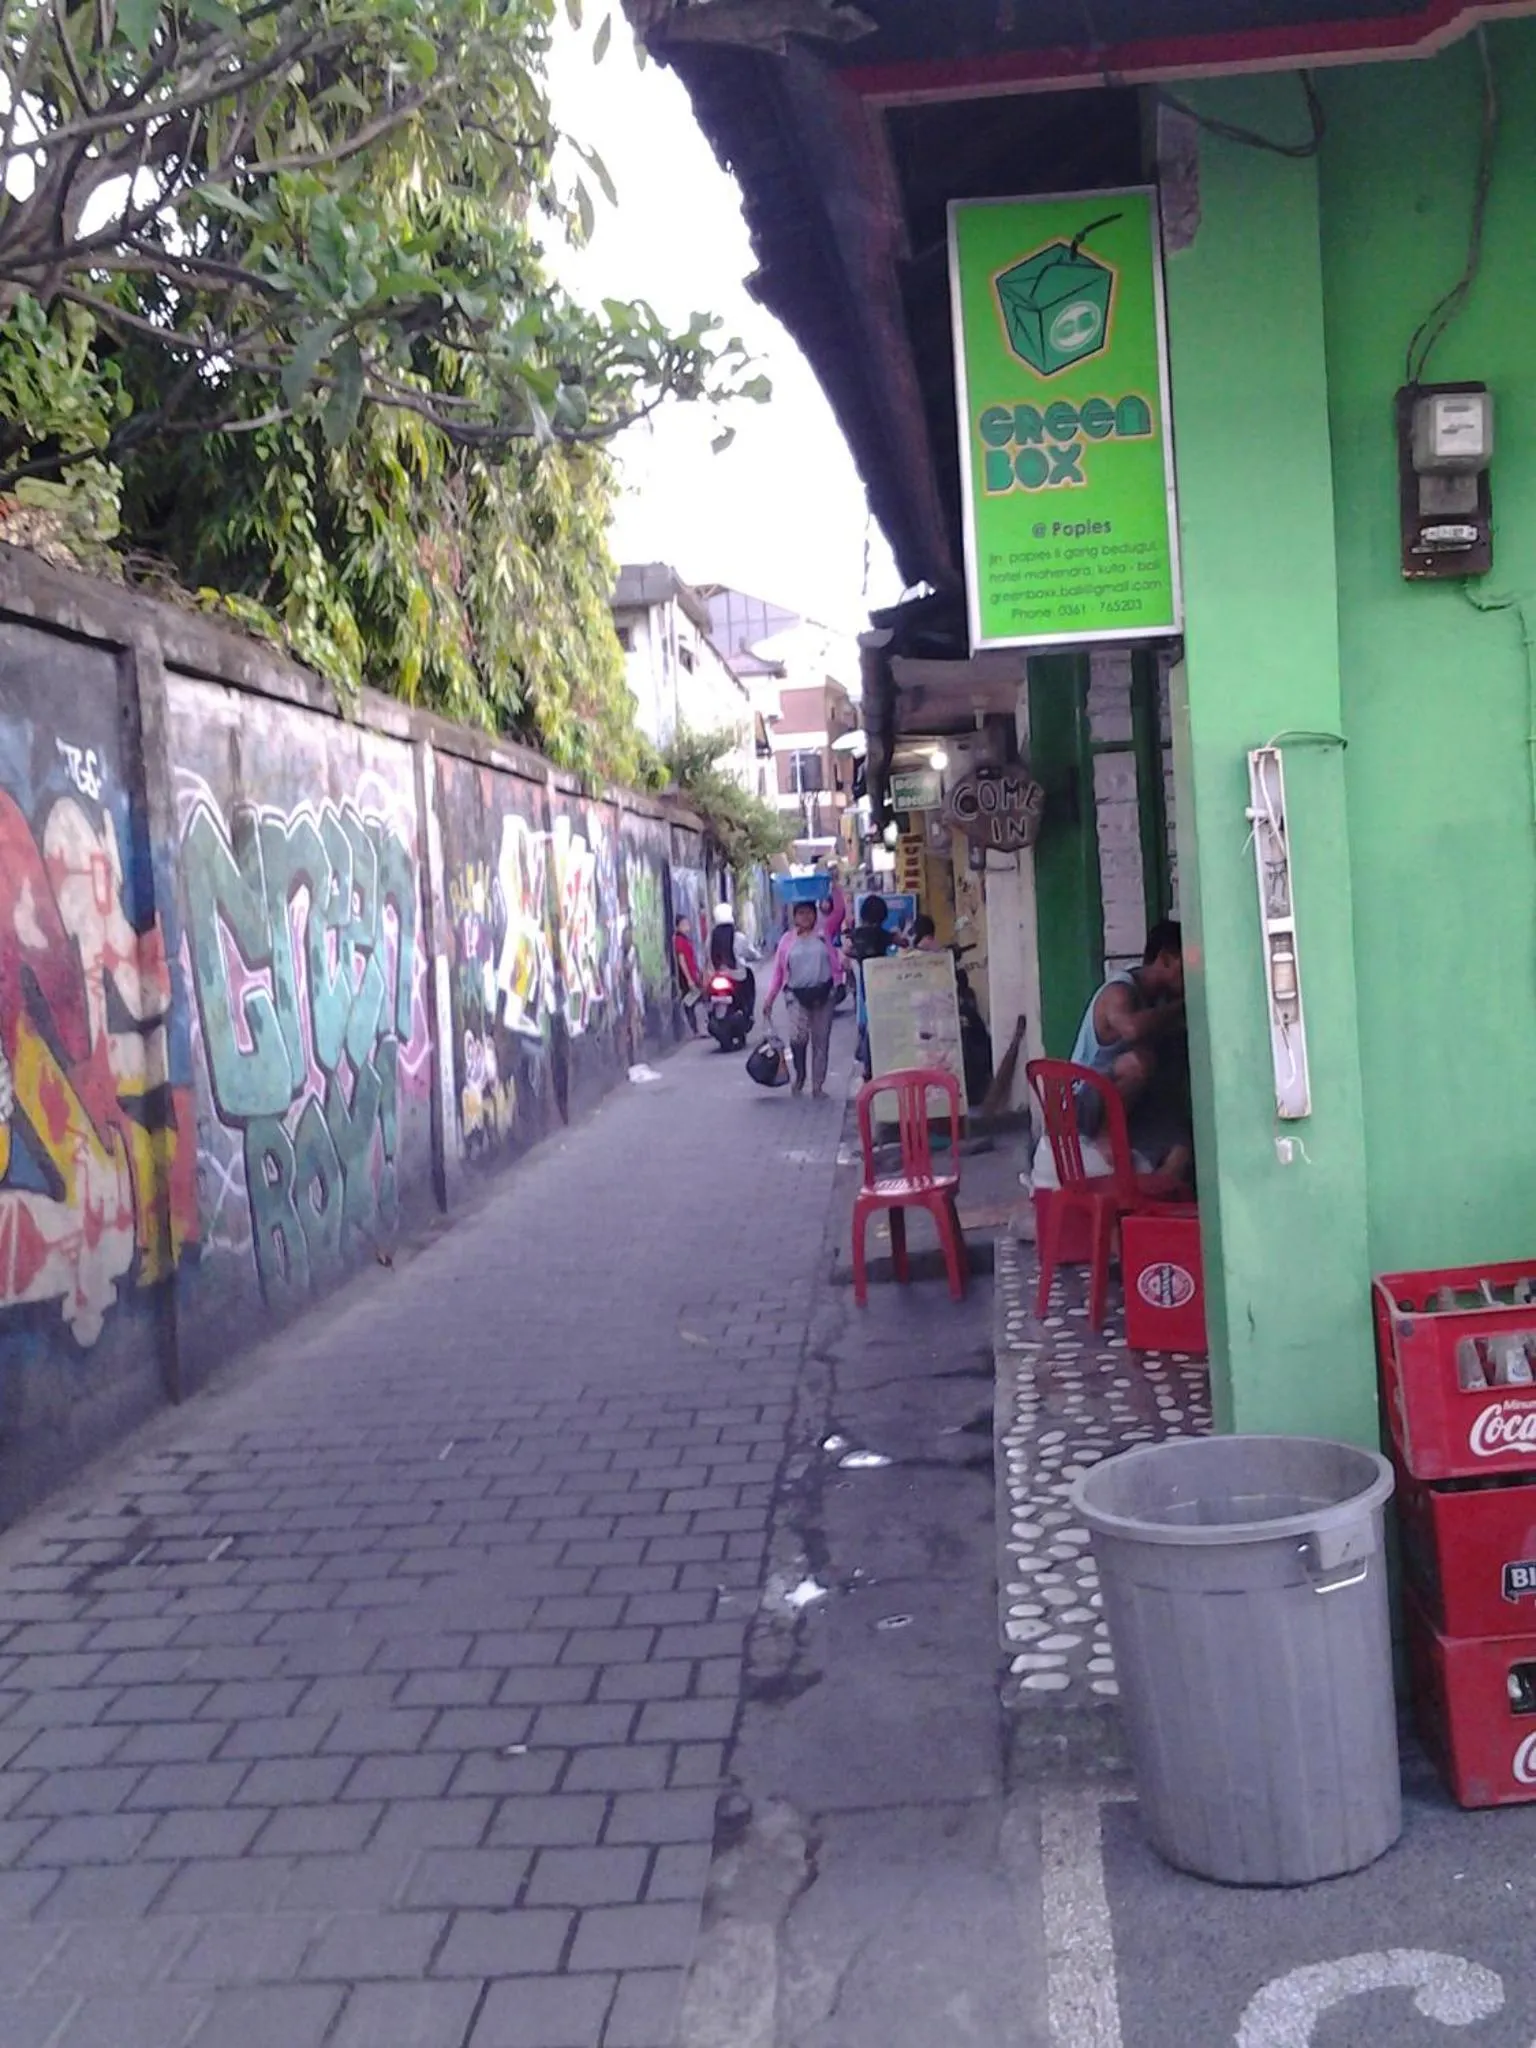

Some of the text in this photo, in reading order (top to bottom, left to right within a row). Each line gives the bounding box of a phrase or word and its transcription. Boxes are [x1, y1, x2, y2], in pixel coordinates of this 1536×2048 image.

[985, 443, 1086, 491] BOX
[1032, 519, 1112, 539] @ Popies
[953, 777, 1044, 820] COME
[991, 815, 1028, 844] IN
